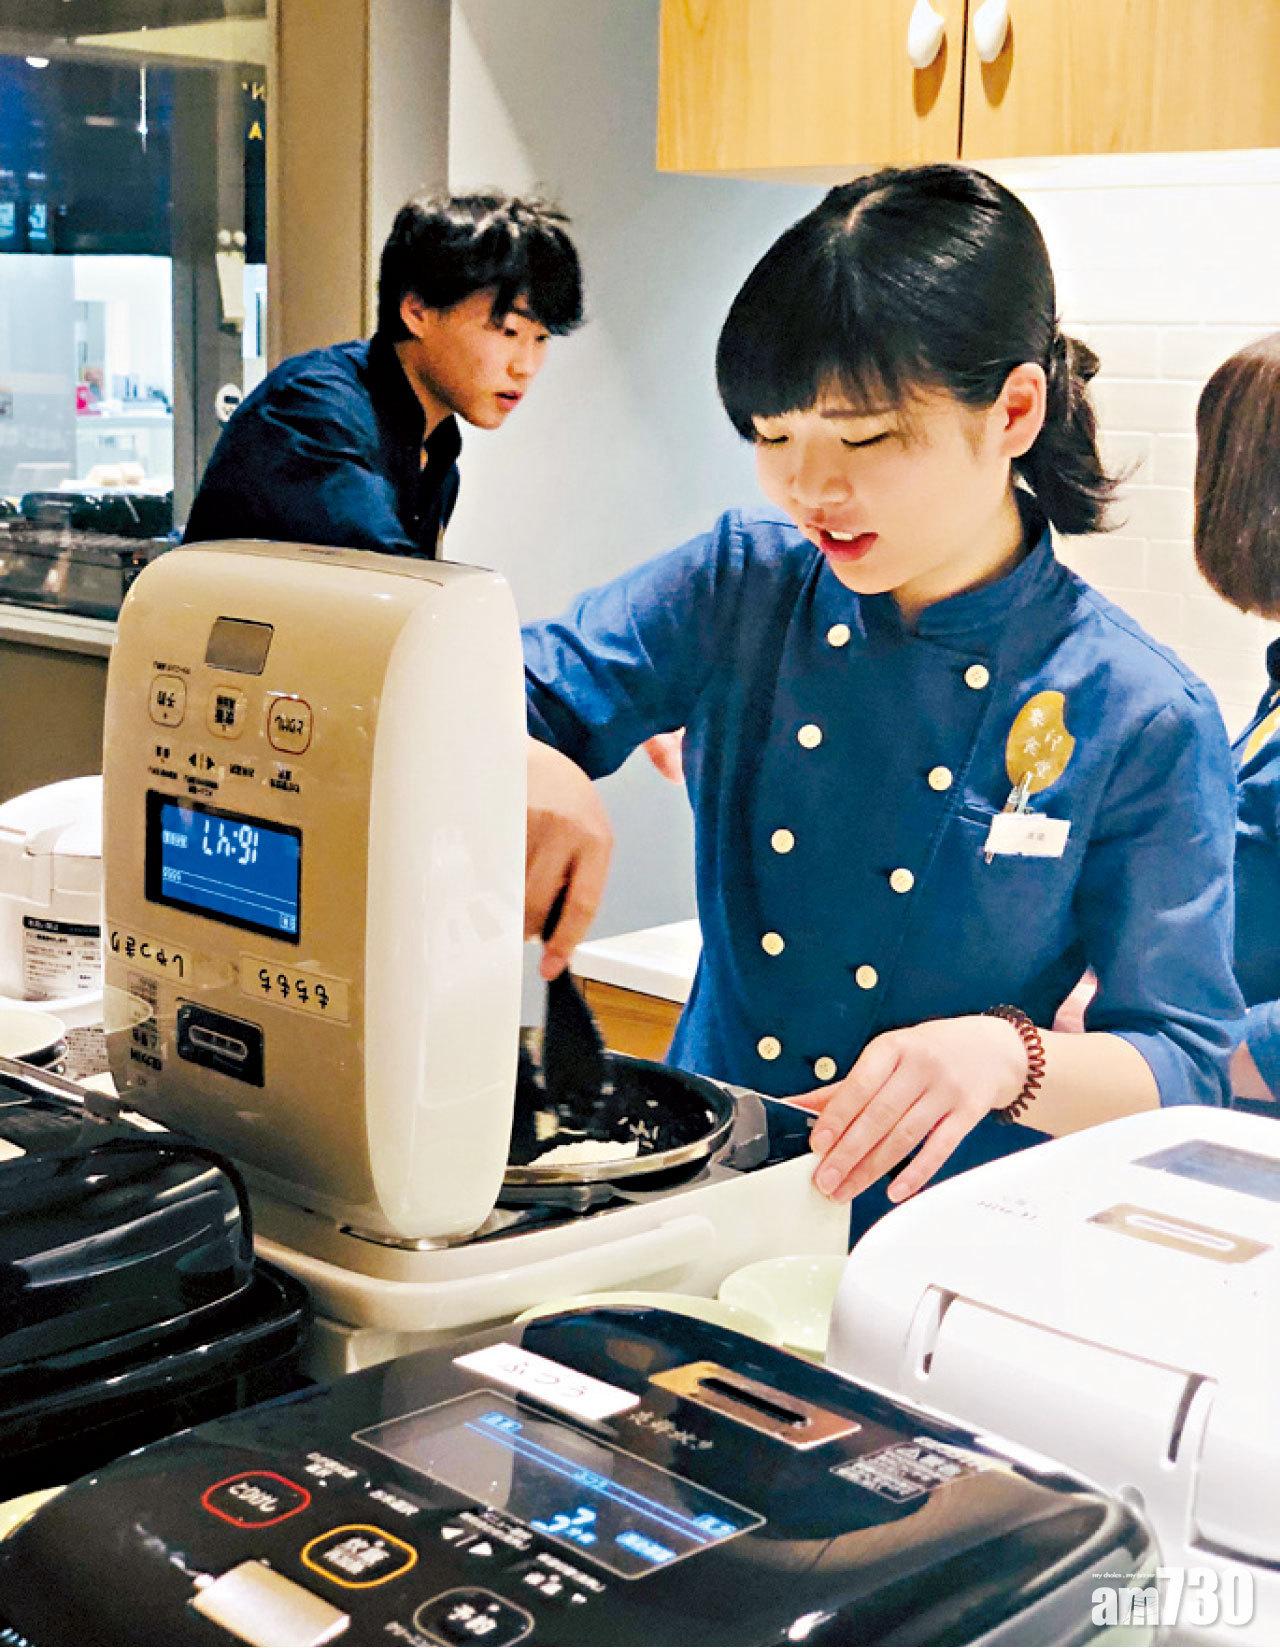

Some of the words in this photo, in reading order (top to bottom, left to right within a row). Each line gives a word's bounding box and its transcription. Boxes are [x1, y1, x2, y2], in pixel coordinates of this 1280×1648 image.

[110, 931, 184, 978] しゃっきり
[259, 969, 330, 1009] もちもち
